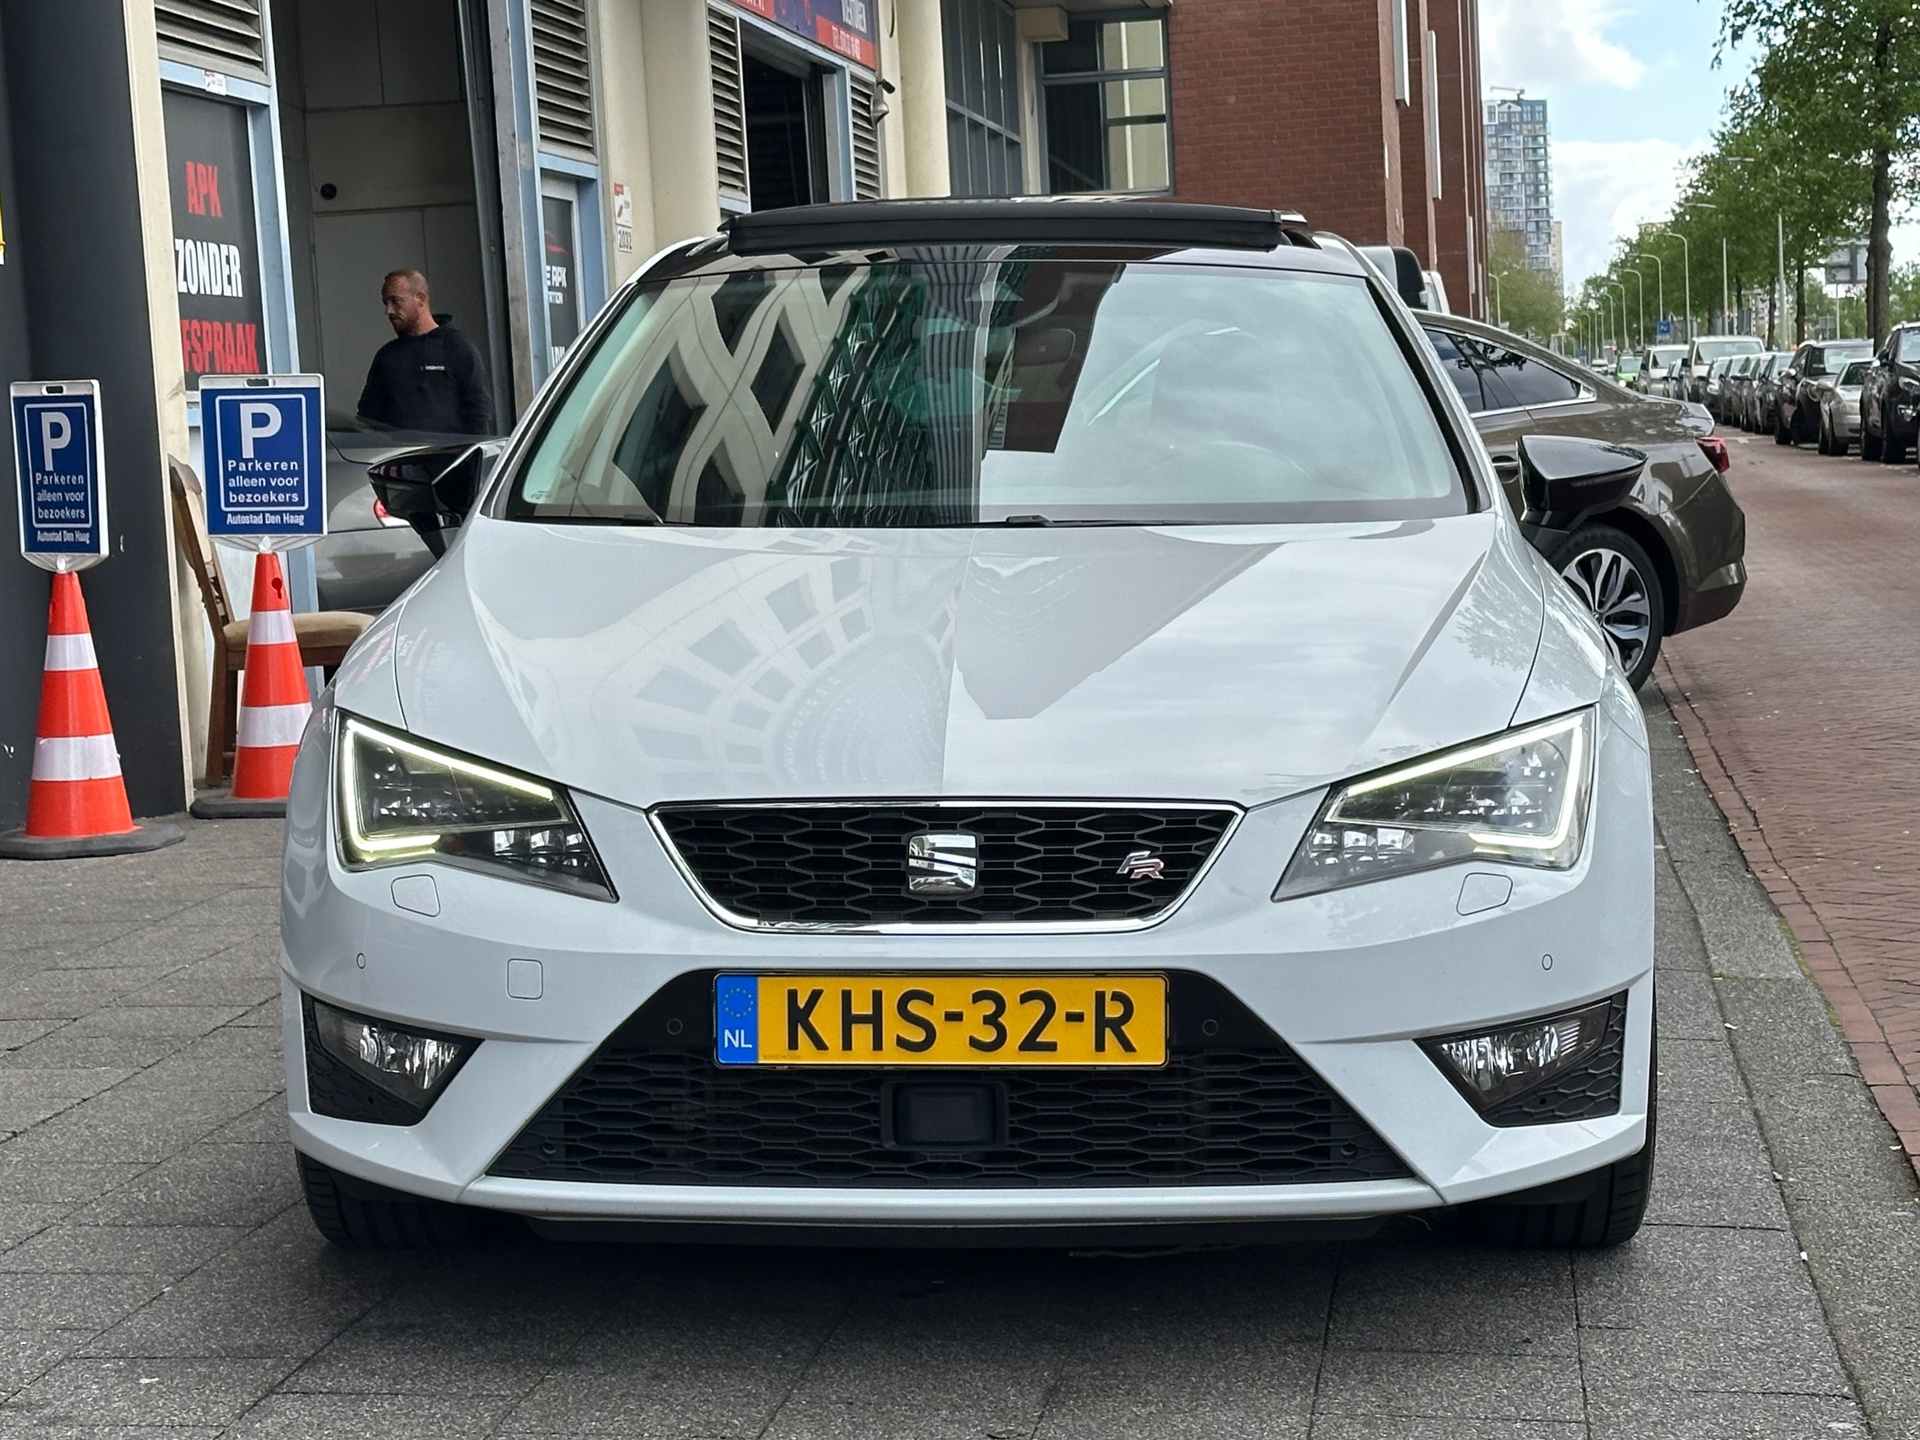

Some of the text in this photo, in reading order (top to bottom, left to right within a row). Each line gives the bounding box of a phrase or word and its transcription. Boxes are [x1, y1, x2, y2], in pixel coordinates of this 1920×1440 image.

[185, 161, 223, 218] APK
[174, 238, 243, 298] ZONDER
[551, 266, 567, 288] APK
[240, 402, 282, 459] P
[41, 411, 71, 471] P
[228, 459, 298, 471] Parkeren
[35, 472, 84, 485] Parkeren
[228, 475, 299, 487] alleen voor
[36, 489, 85, 502] alleen voor
[229, 490, 299, 503] bezoekers
[37, 506, 85, 519] bezoekers
[226, 513, 304, 526] Autostad Den Haag
[37, 530, 90, 544] Autostad Den Haag
[1116, 850, 1165, 880] FR
[724, 988, 1137, 1054] NL KHS-32-R
